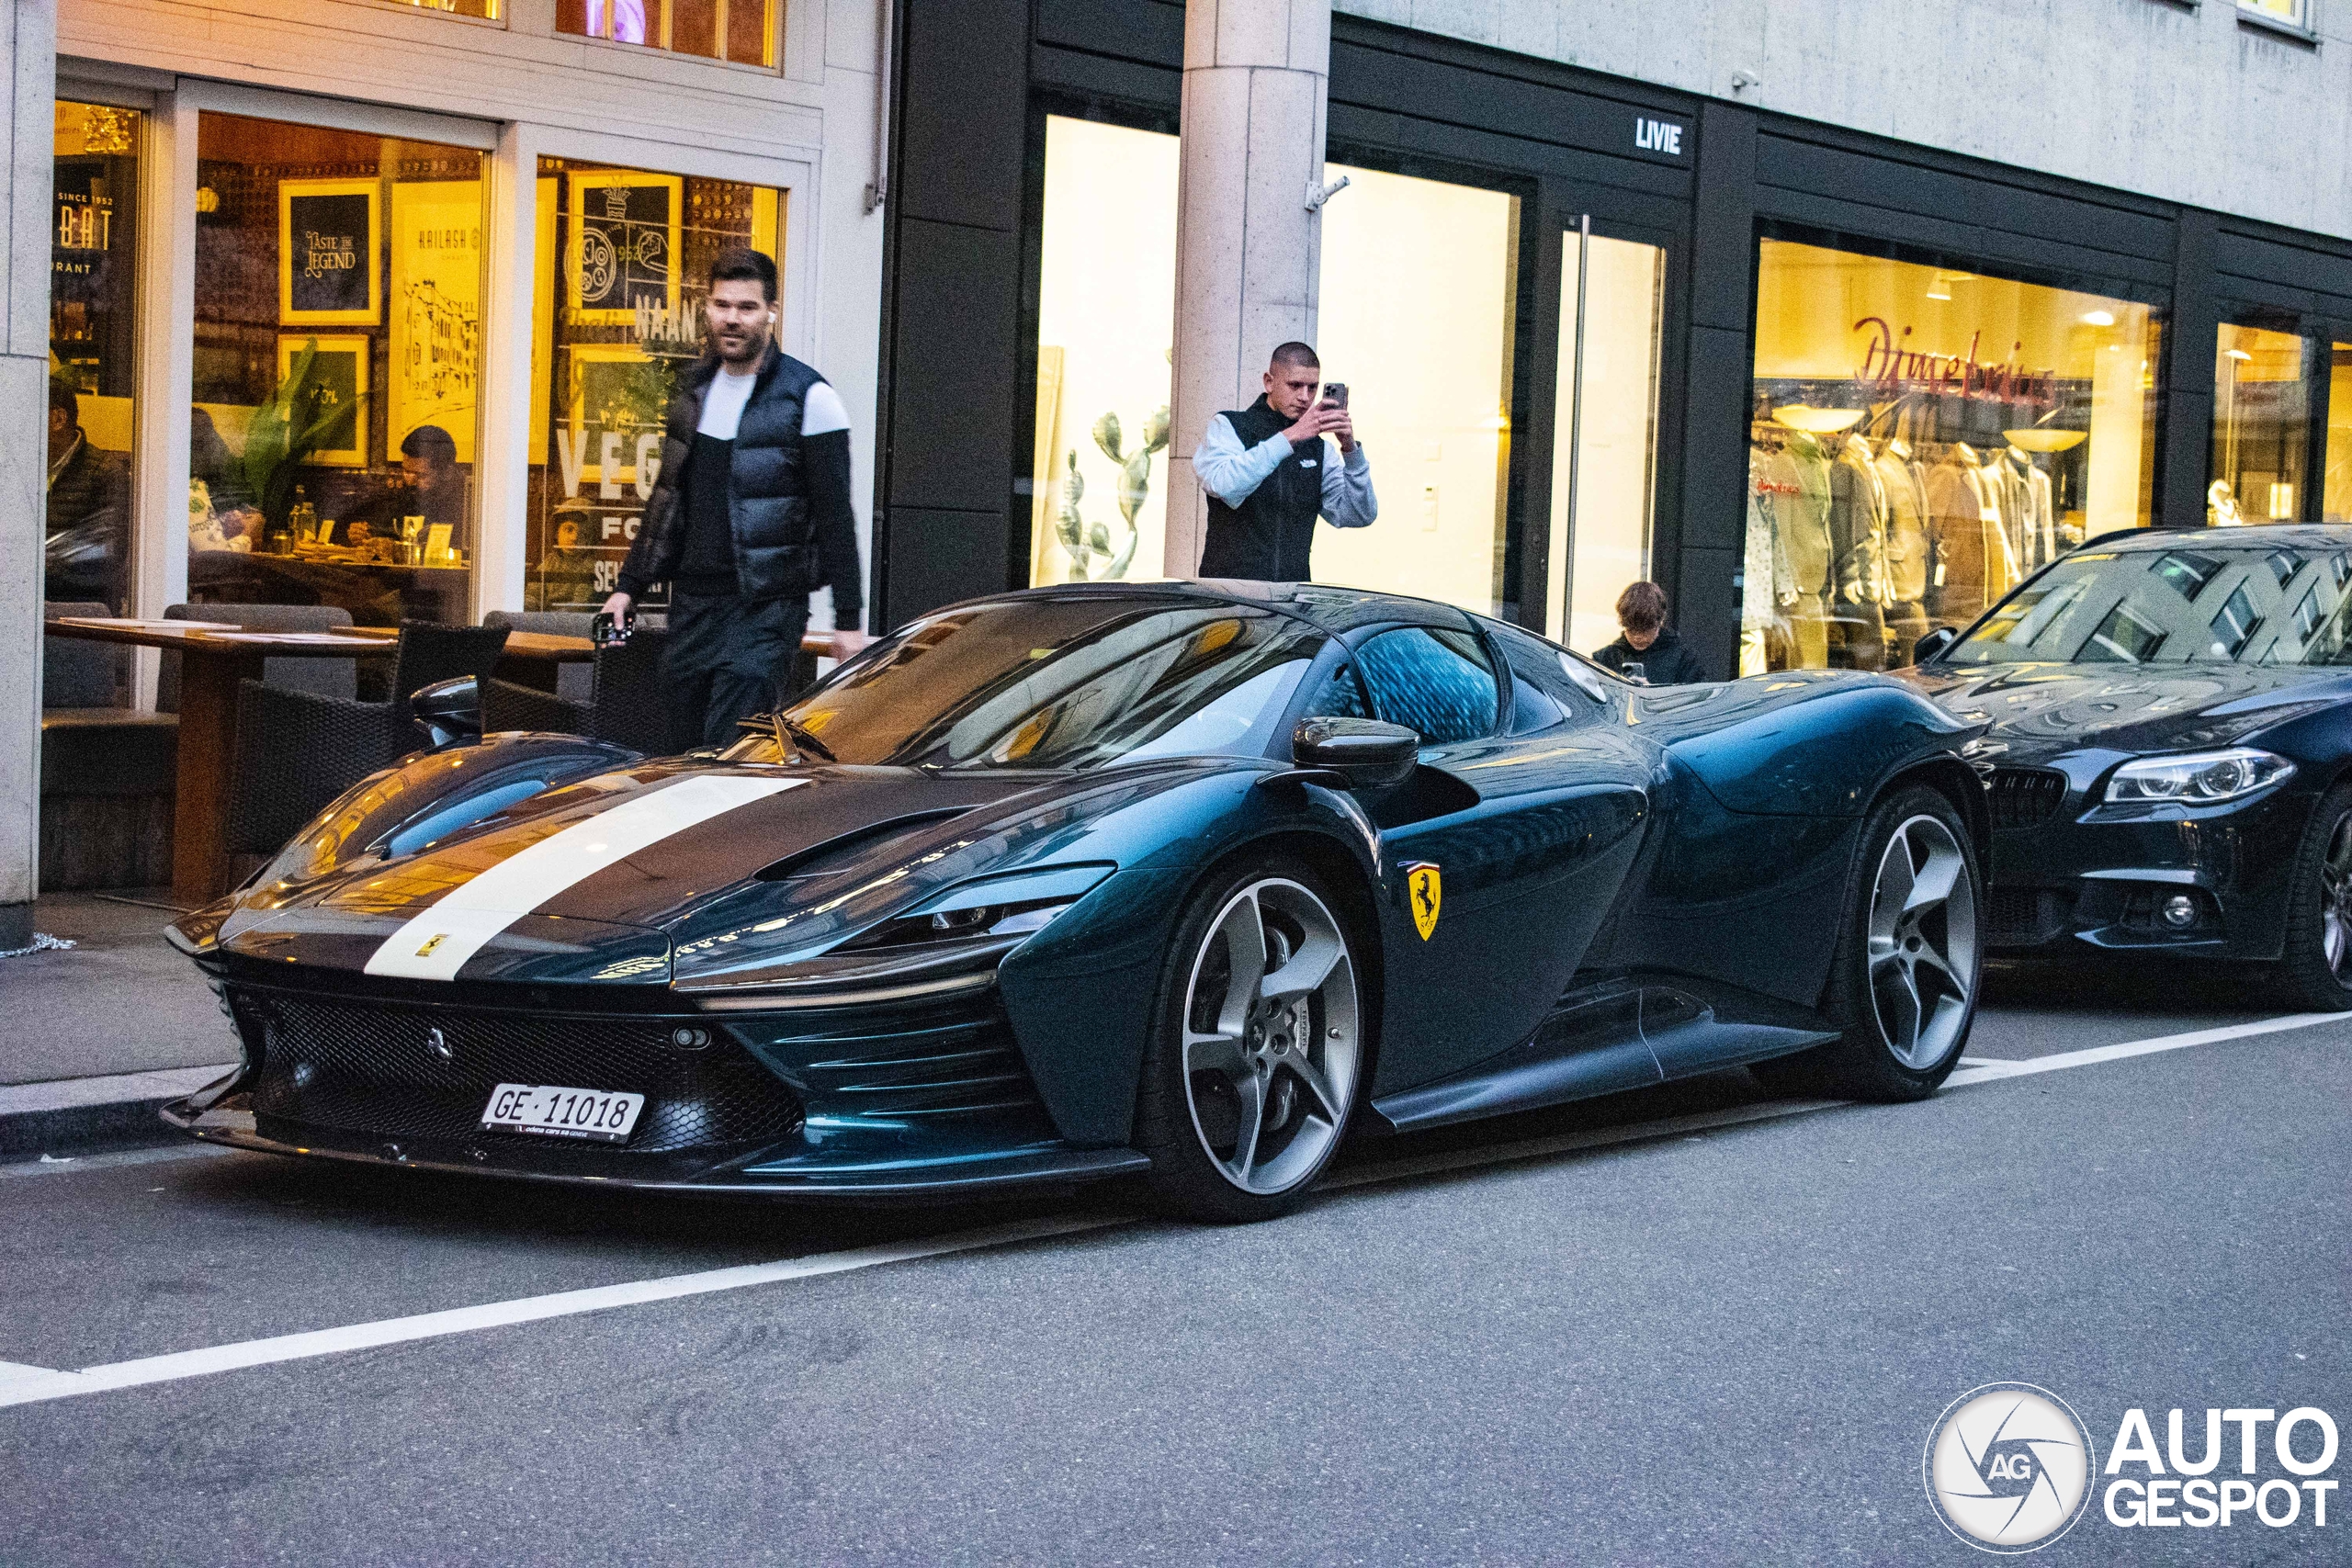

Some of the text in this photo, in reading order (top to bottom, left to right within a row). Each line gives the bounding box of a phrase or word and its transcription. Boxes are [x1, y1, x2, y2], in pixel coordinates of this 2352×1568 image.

[1635, 118, 1682, 154] LIVIE
[58, 192, 113, 206] SINCE 1952
[51, 205, 113, 251] BAT
[634, 293, 696, 344] NAAN
[493, 1089, 630, 1128] GE 11018
